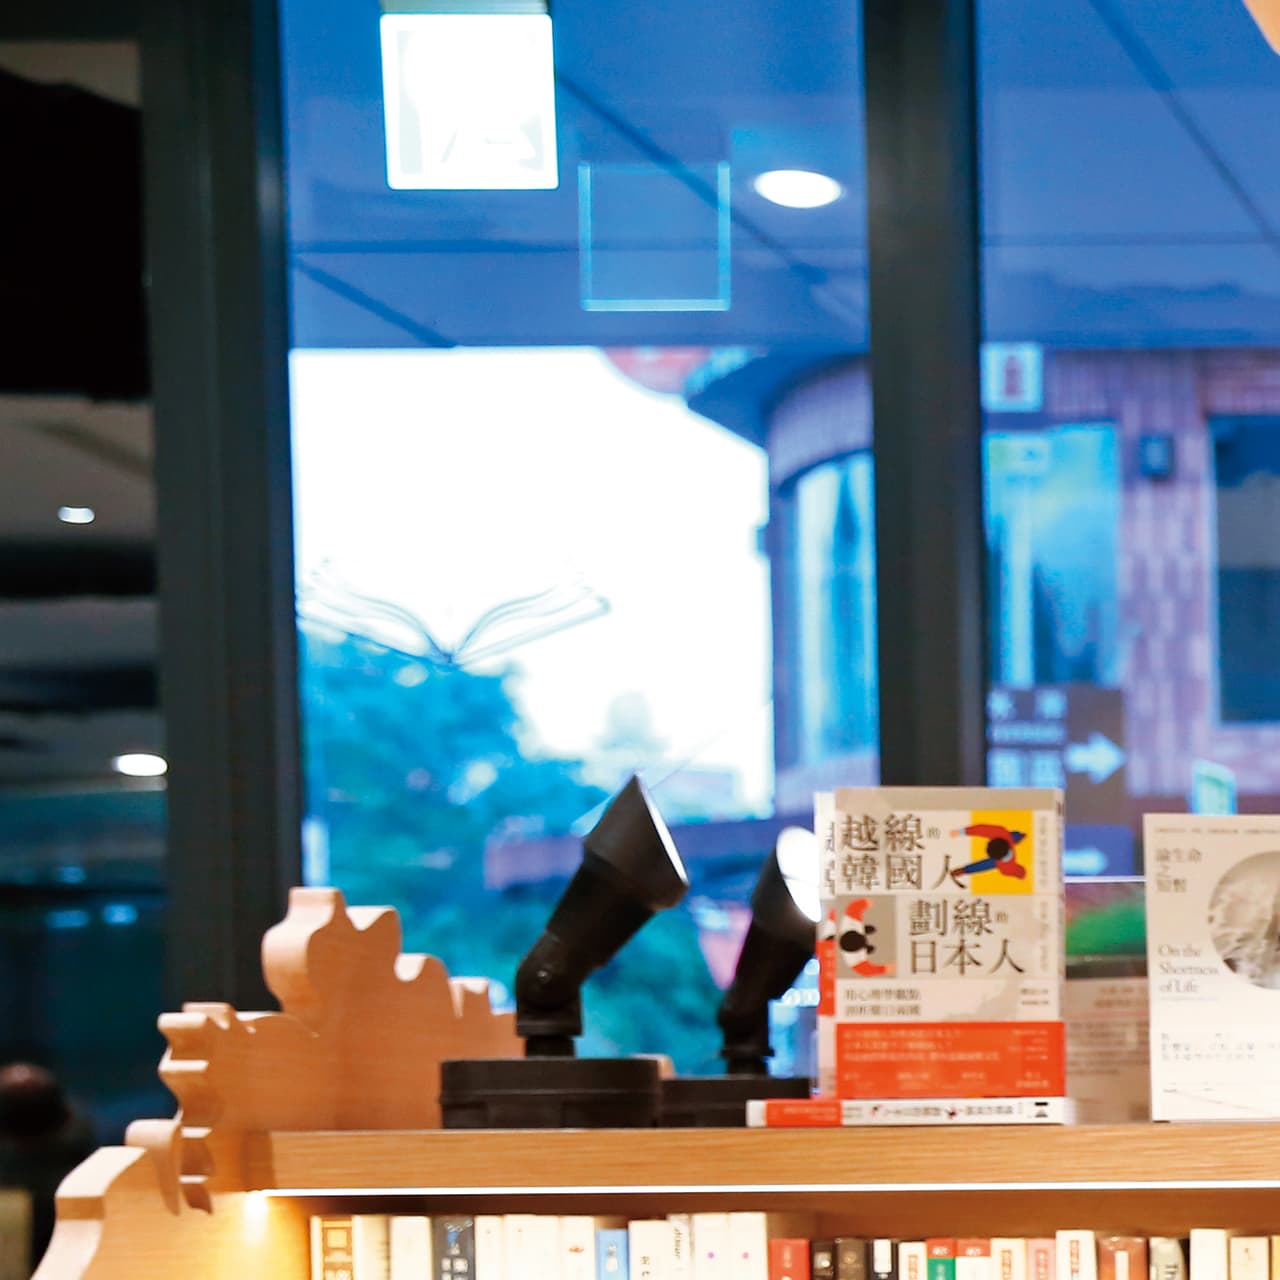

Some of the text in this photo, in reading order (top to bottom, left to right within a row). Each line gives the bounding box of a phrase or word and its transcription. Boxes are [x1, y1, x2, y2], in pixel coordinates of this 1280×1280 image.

[841, 813, 925, 852] 越線
[842, 854, 970, 892] 韓國人
[910, 900, 993, 937] 劃線
[911, 939, 1025, 976] 日本人
